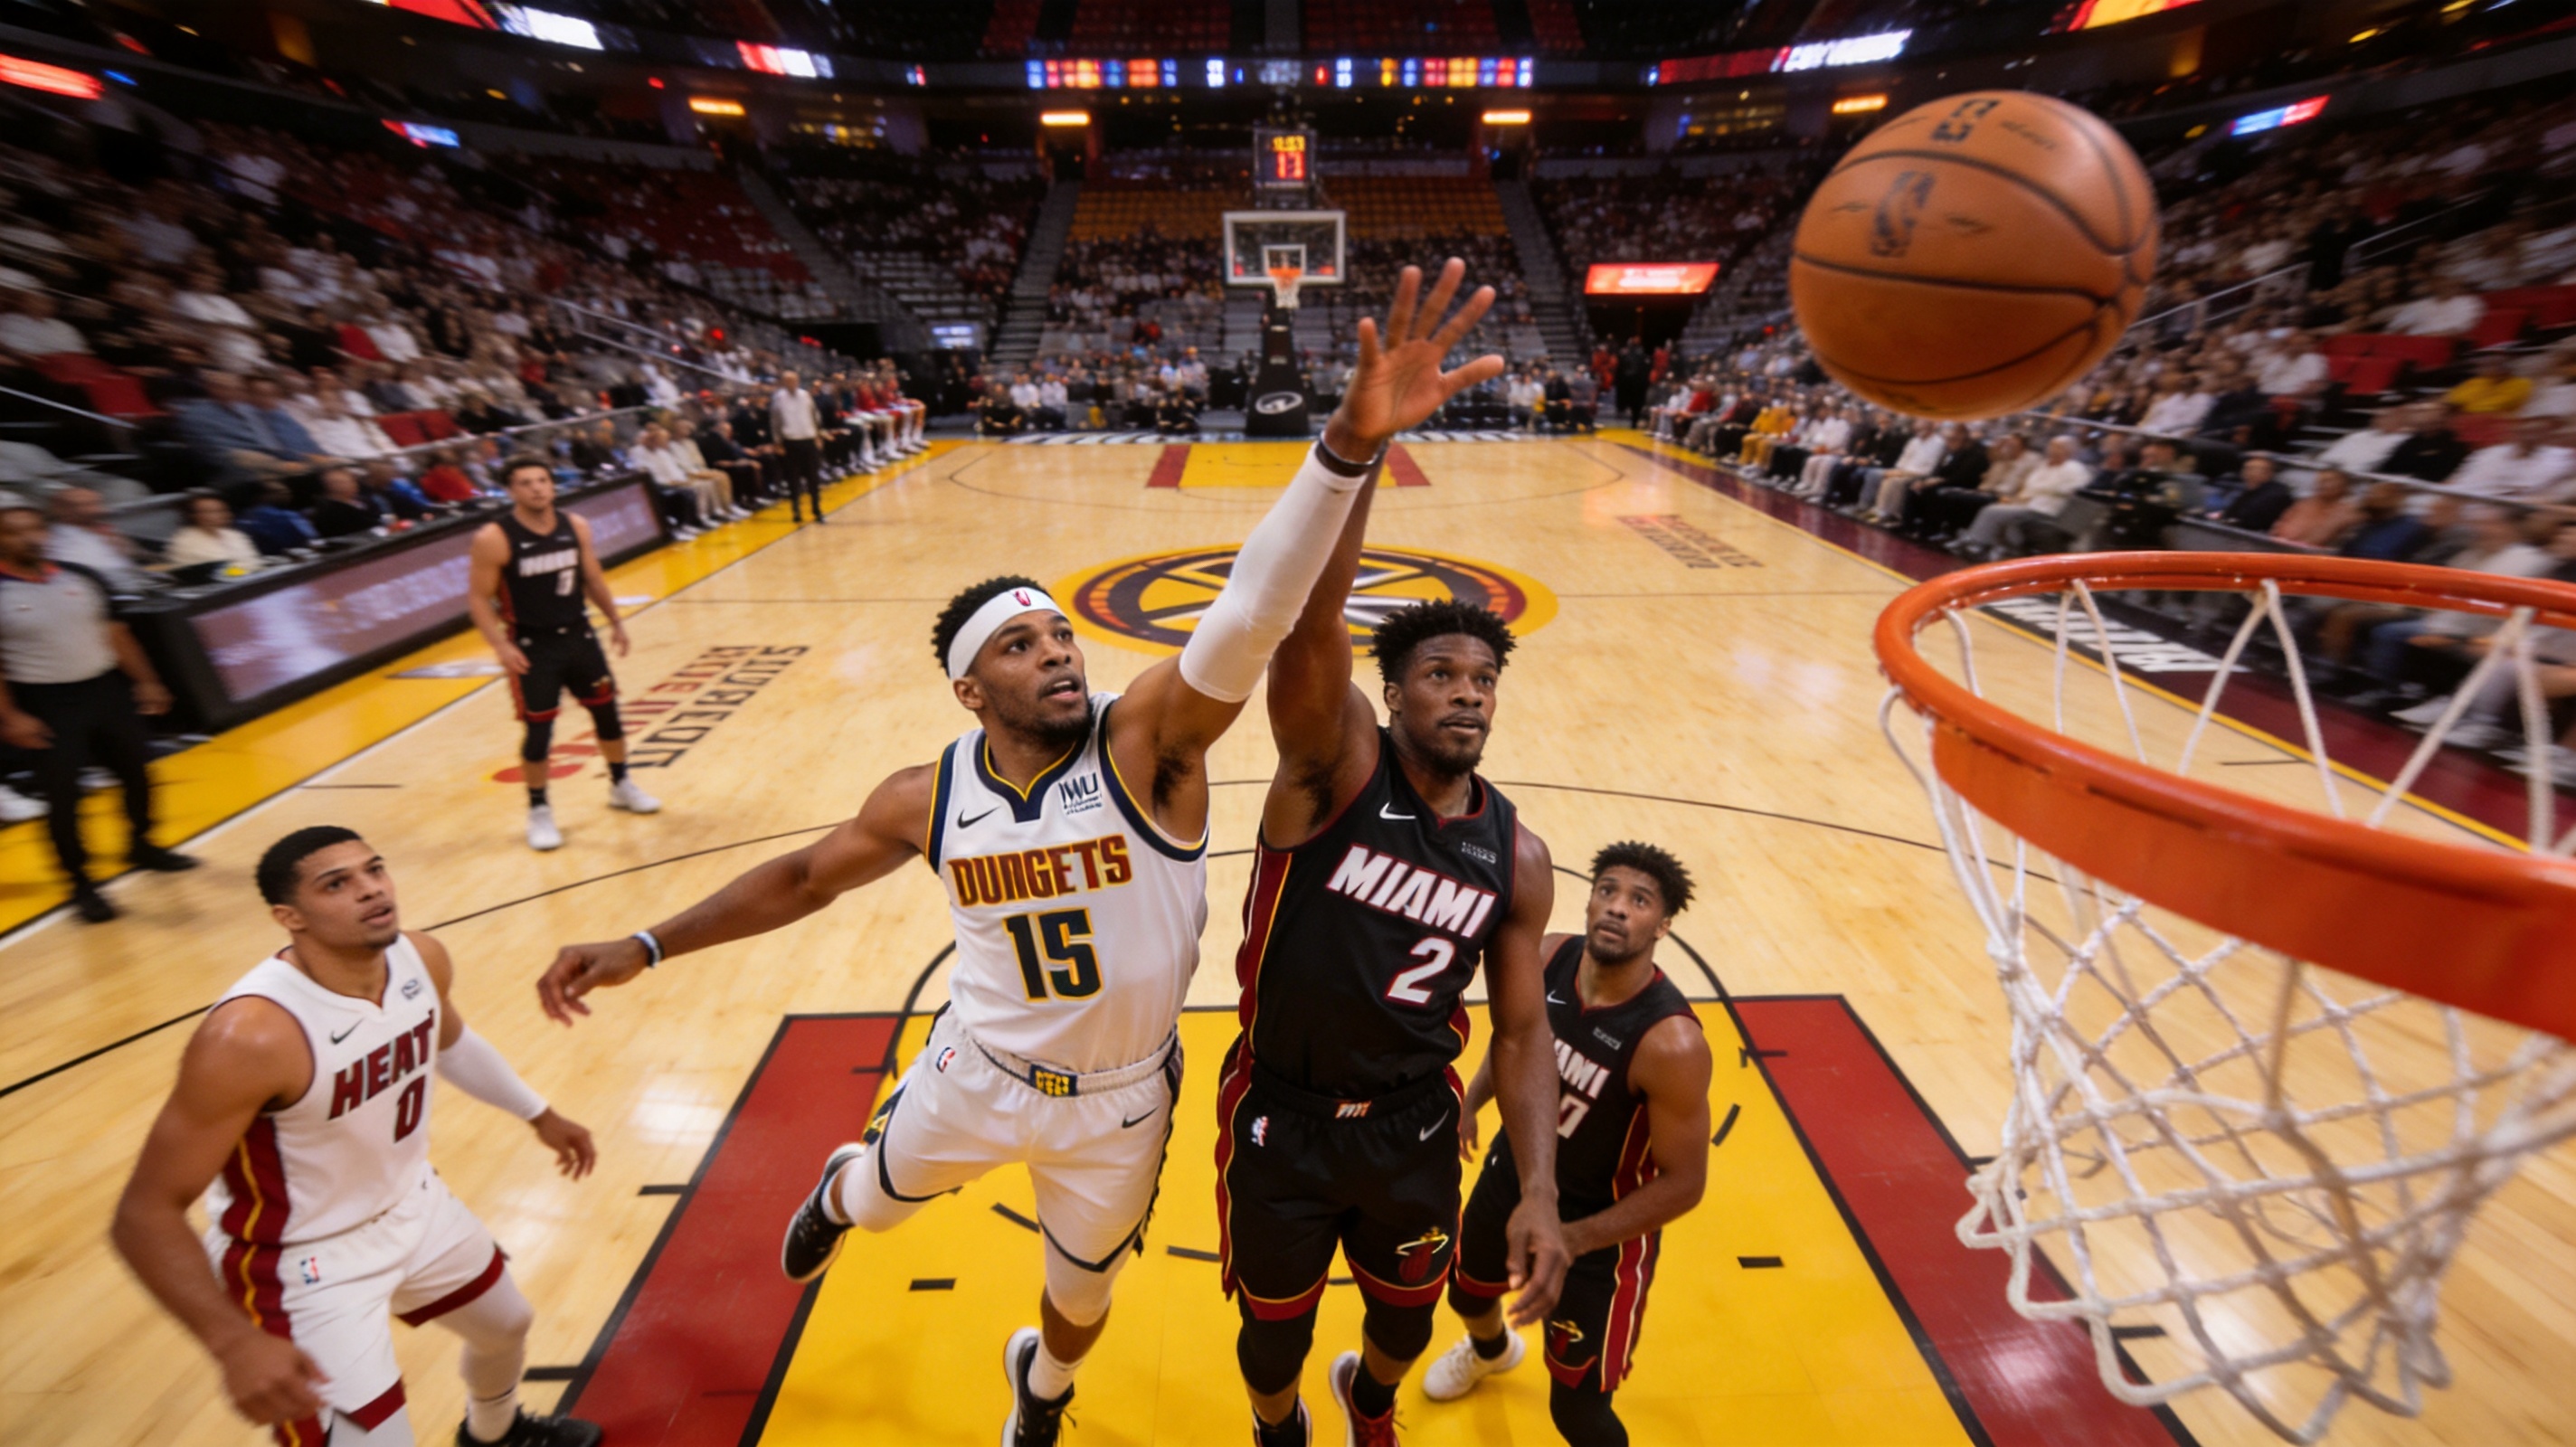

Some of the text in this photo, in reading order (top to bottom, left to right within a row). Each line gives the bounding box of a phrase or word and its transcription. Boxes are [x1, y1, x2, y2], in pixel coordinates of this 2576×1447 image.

[1326, 843, 1497, 938] MIAMI
[1002, 906, 1104, 1003] 15
[1385, 935, 1455, 1006] 2
[327, 1008, 434, 1121] HEAT
[393, 1074, 426, 1144] 0
